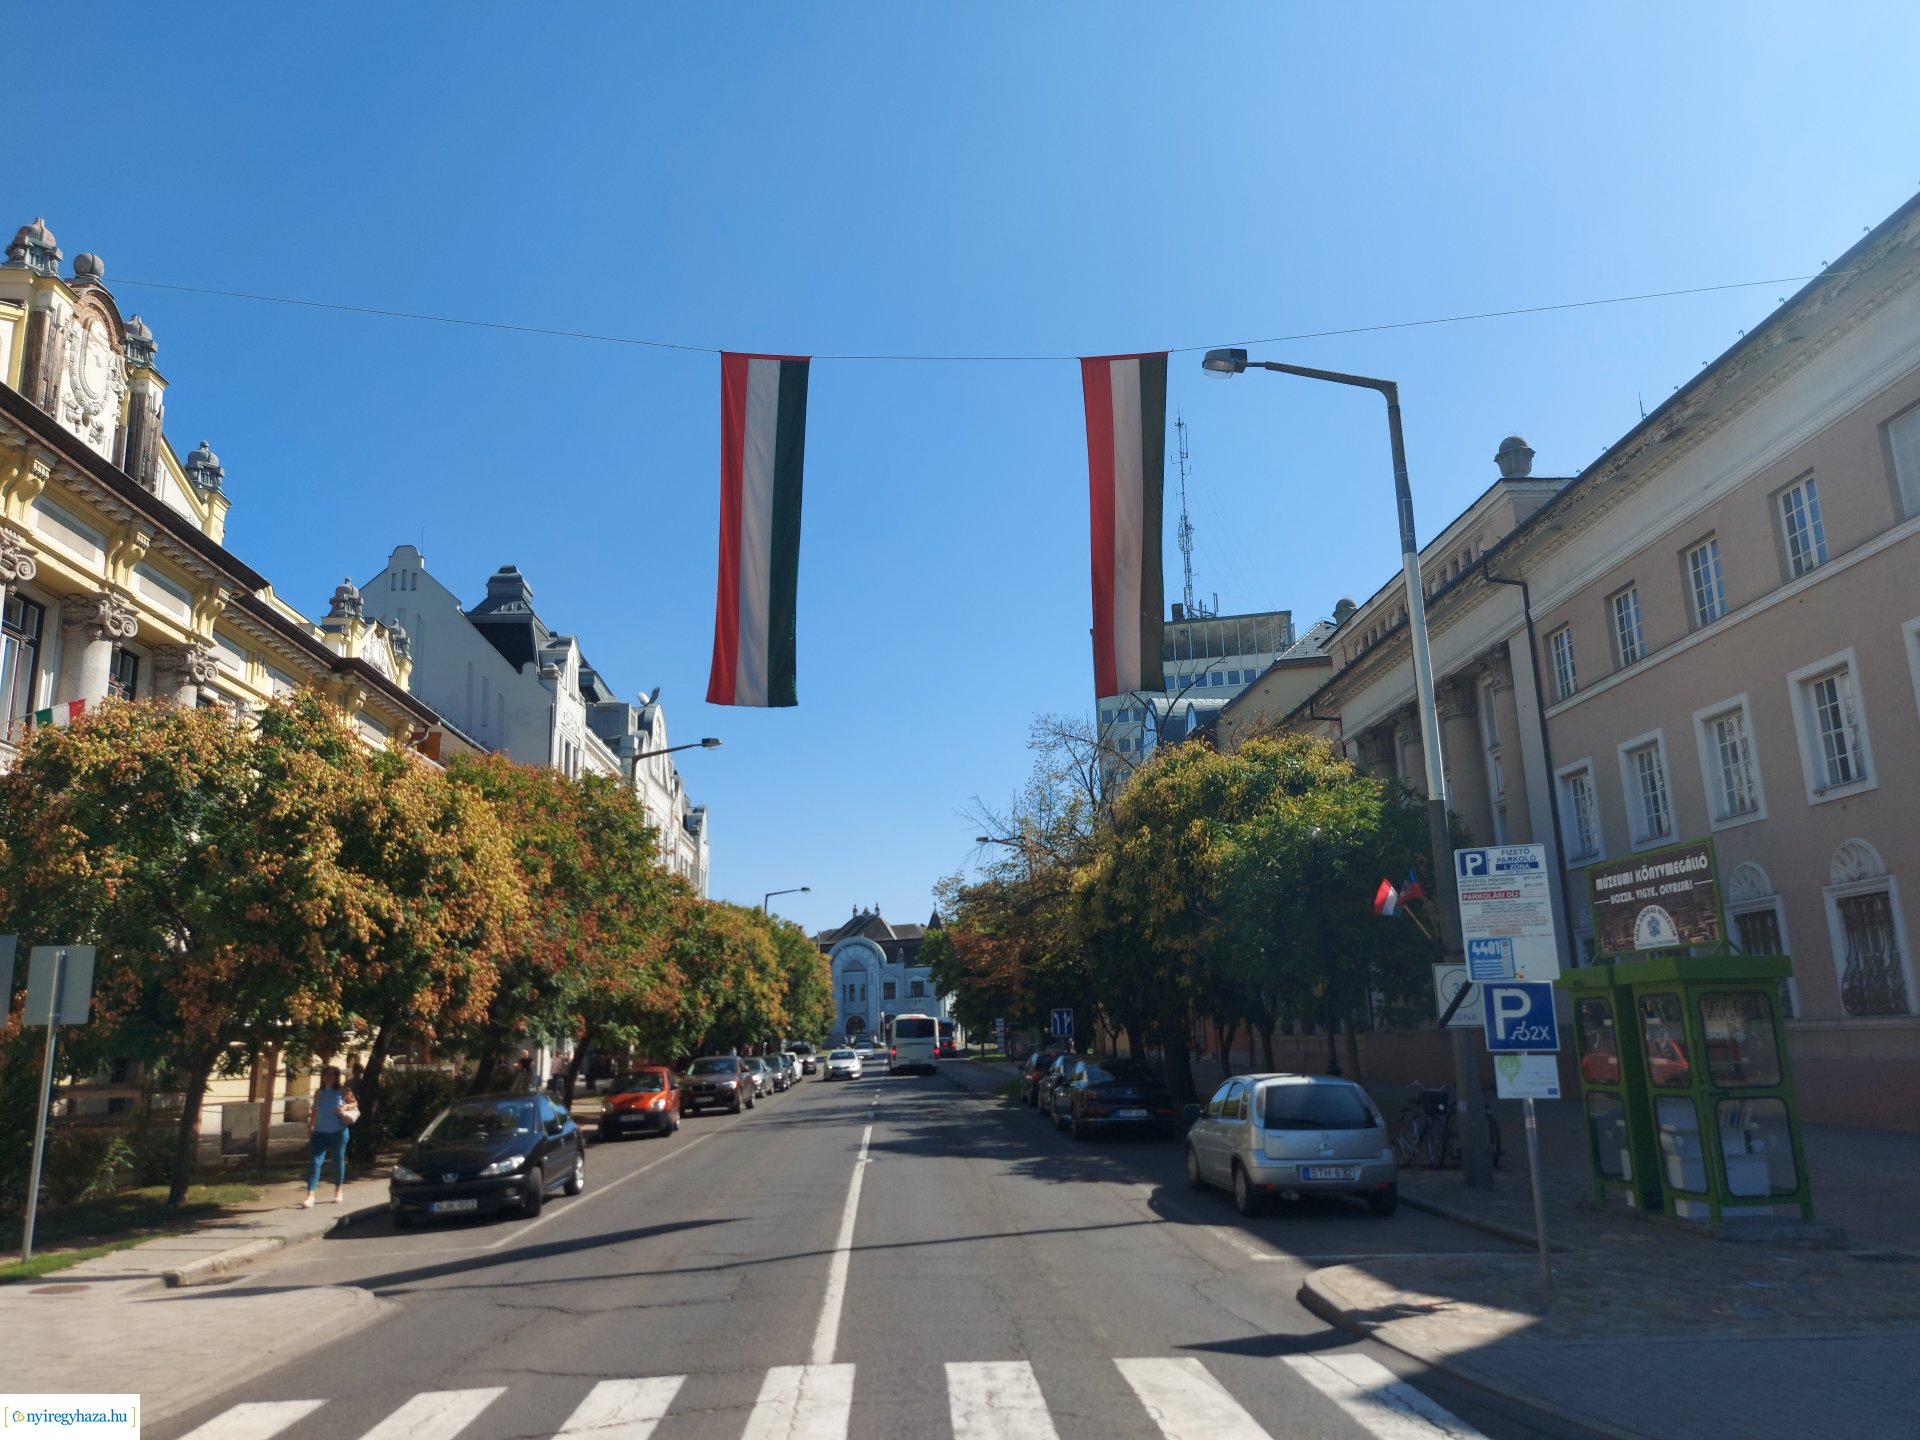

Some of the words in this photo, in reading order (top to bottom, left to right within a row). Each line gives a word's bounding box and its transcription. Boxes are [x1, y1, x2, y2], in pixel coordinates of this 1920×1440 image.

[1496, 854, 1536, 863] PARKOLÓ
[1595, 872, 1633, 890] MÚZEUMI
[1635, 852, 1707, 882] KÖNYVMEGÁLLÓ
[1462, 891, 1505, 900] PARKOLÁSI
[1472, 941, 1500, 956] 4401
[1492, 988, 1531, 1040] P
[1530, 1025, 1550, 1041] 2X
